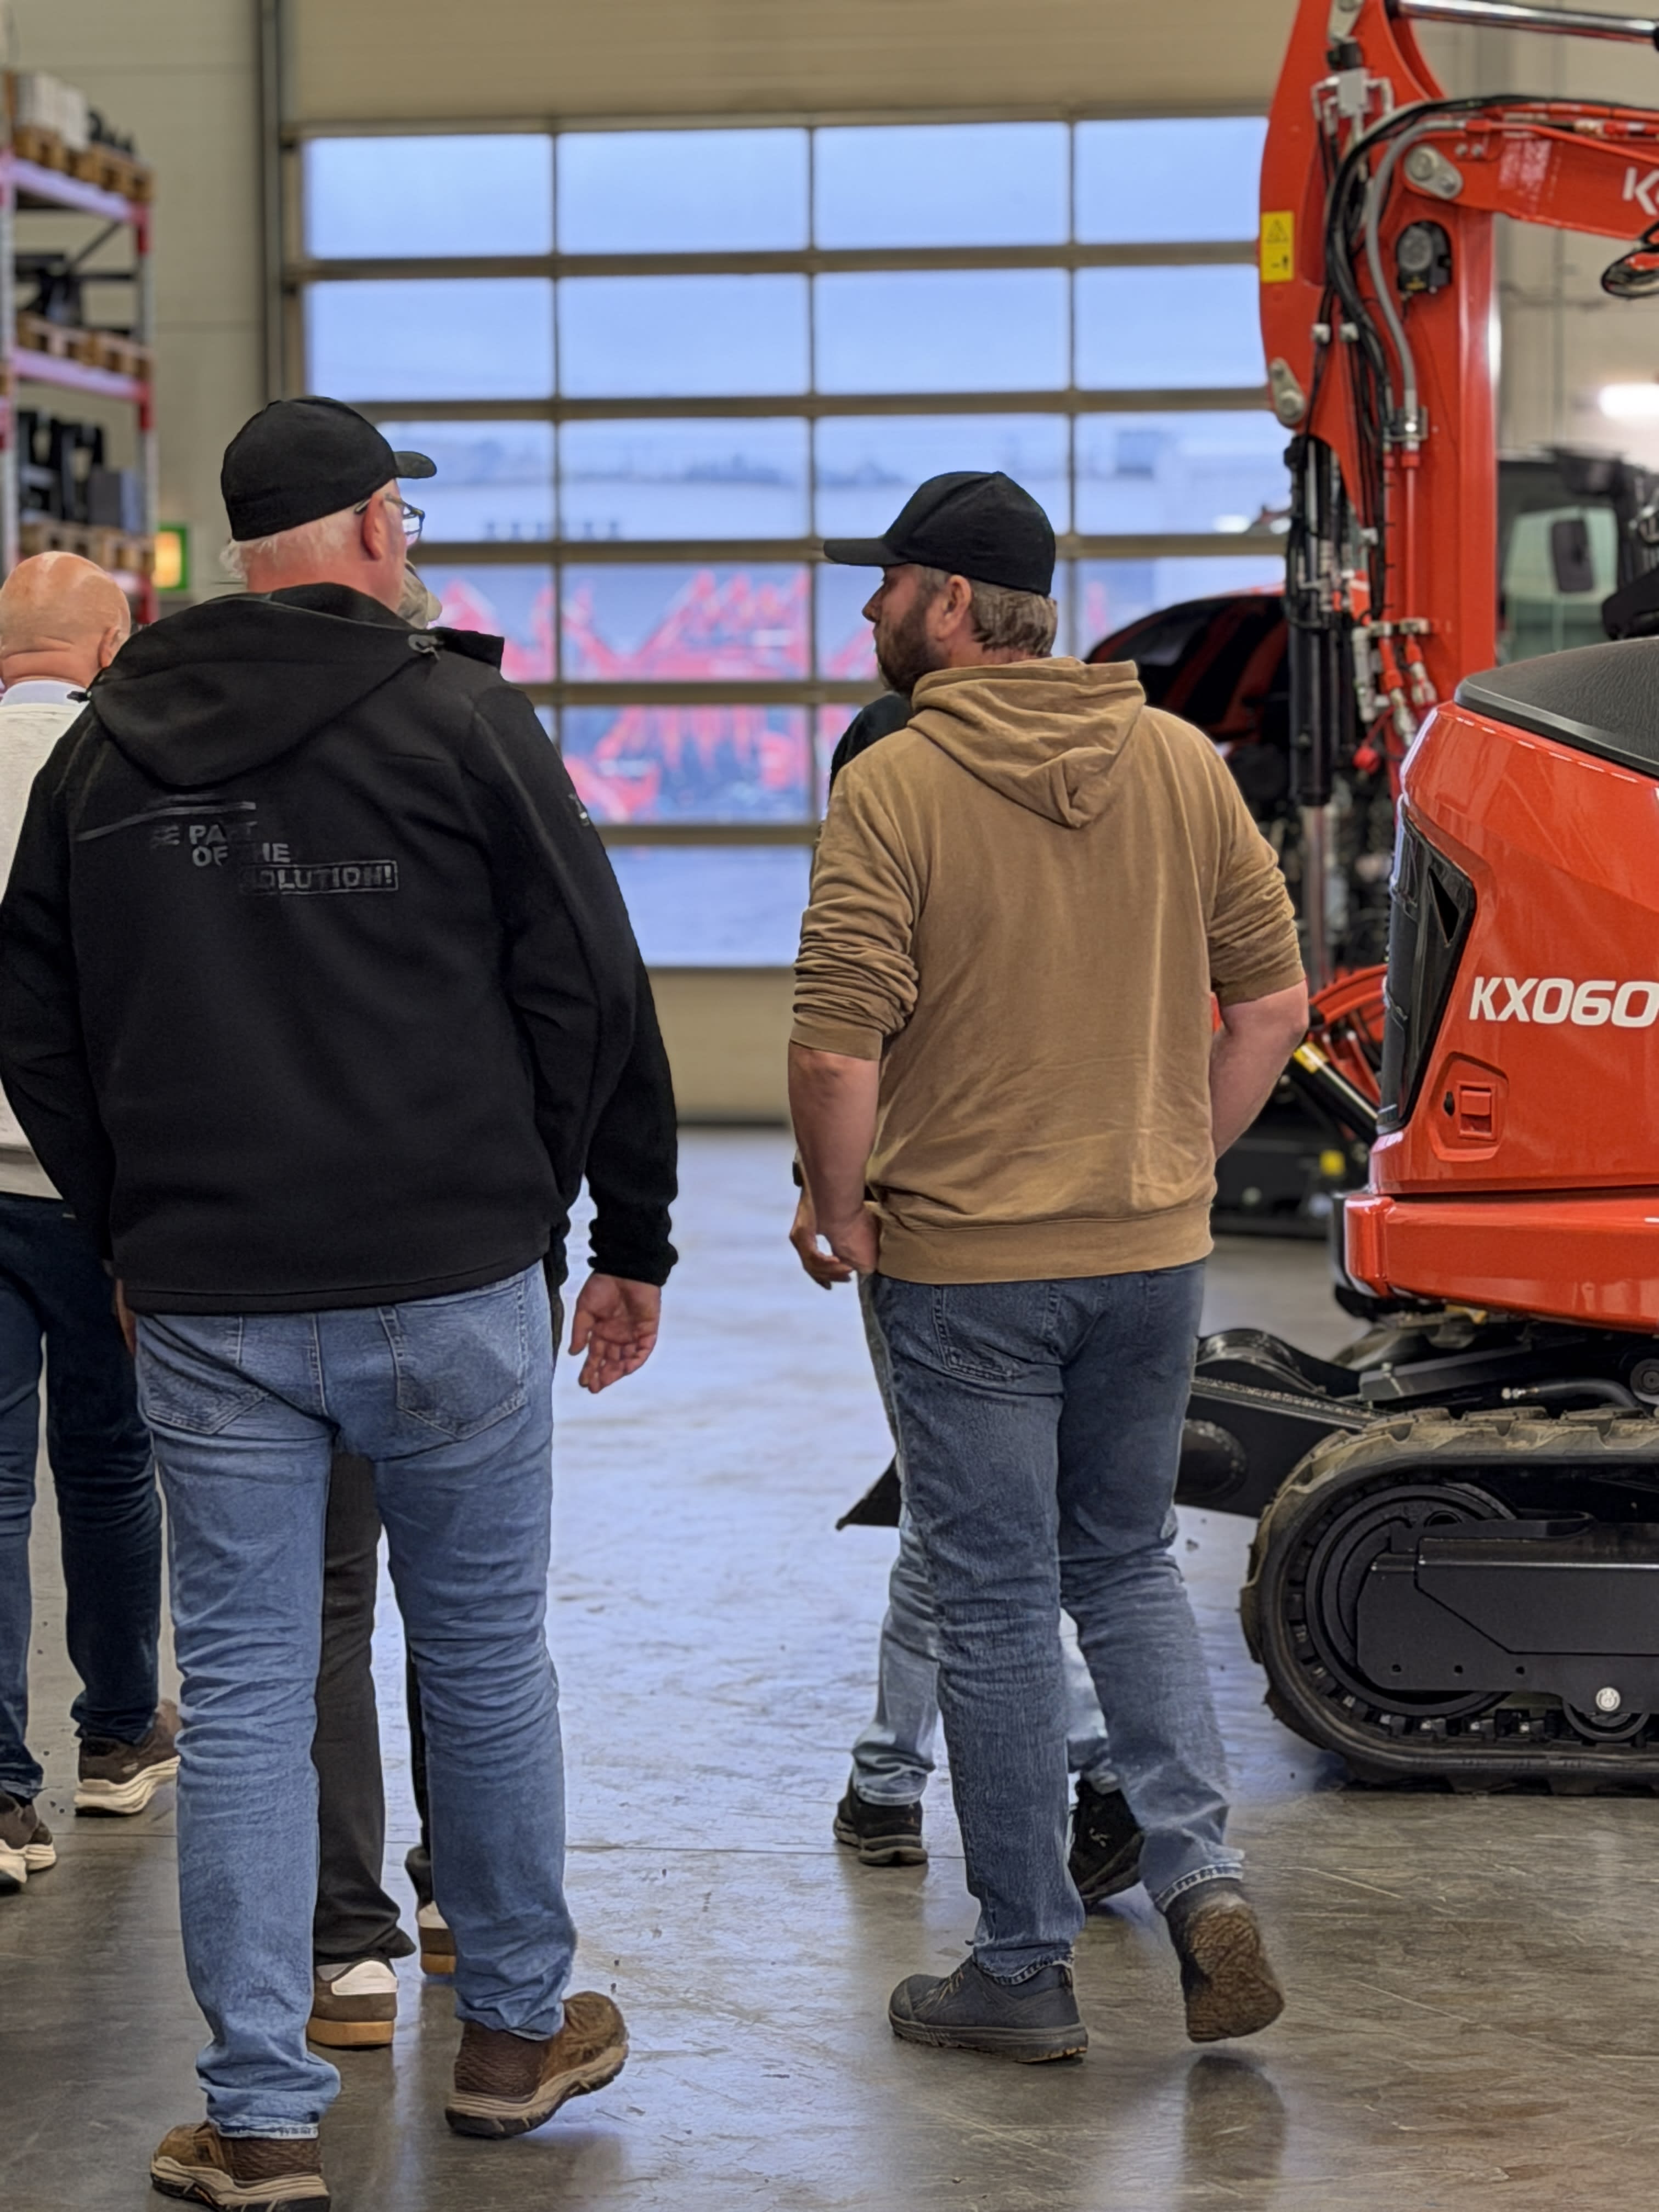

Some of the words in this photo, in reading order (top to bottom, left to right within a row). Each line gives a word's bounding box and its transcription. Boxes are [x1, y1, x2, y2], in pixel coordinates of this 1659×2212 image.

[1622, 166, 1659, 216] K
[189, 821, 258, 845] PAT
[192, 845, 229, 867] OF
[1469, 976, 1659, 1028] KX060
